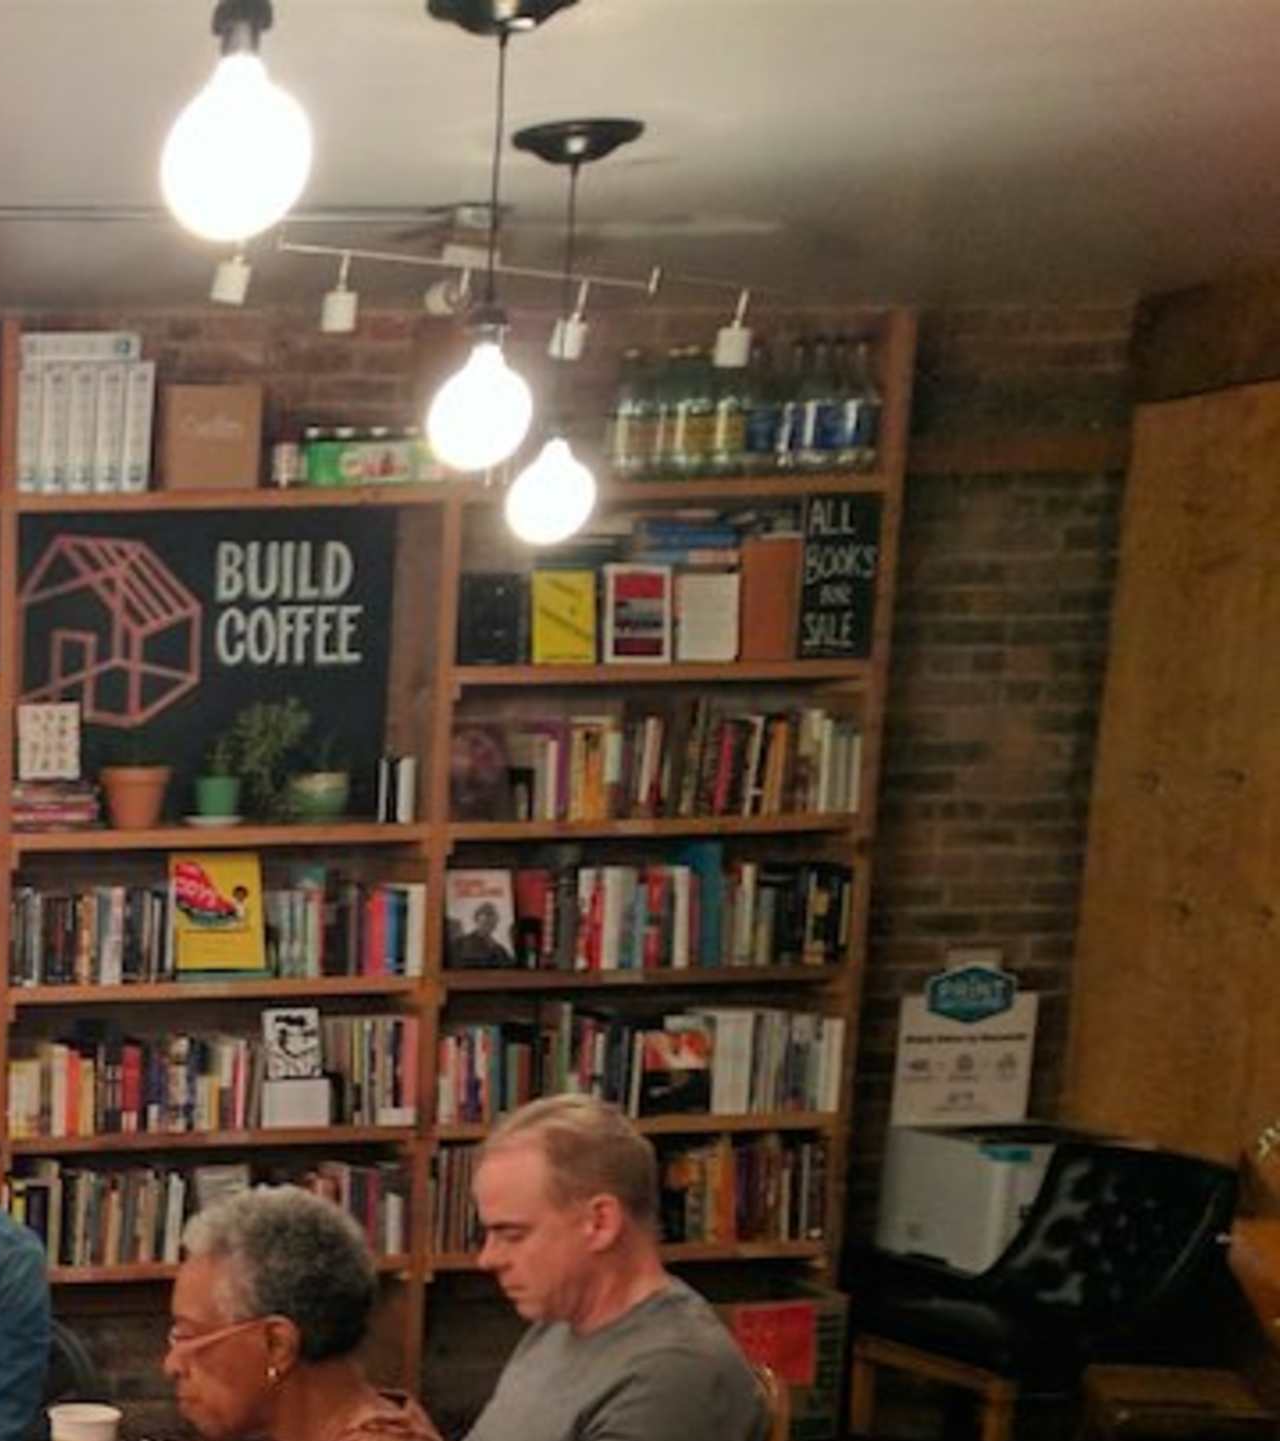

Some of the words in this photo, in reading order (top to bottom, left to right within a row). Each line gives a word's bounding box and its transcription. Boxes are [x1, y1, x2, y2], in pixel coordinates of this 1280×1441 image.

[809, 499, 856, 537] ALL
[215, 540, 354, 601] BUILD
[805, 544, 877, 585] BOOKS
[216, 605, 364, 667] COFFEE
[803, 612, 855, 647] SALE
